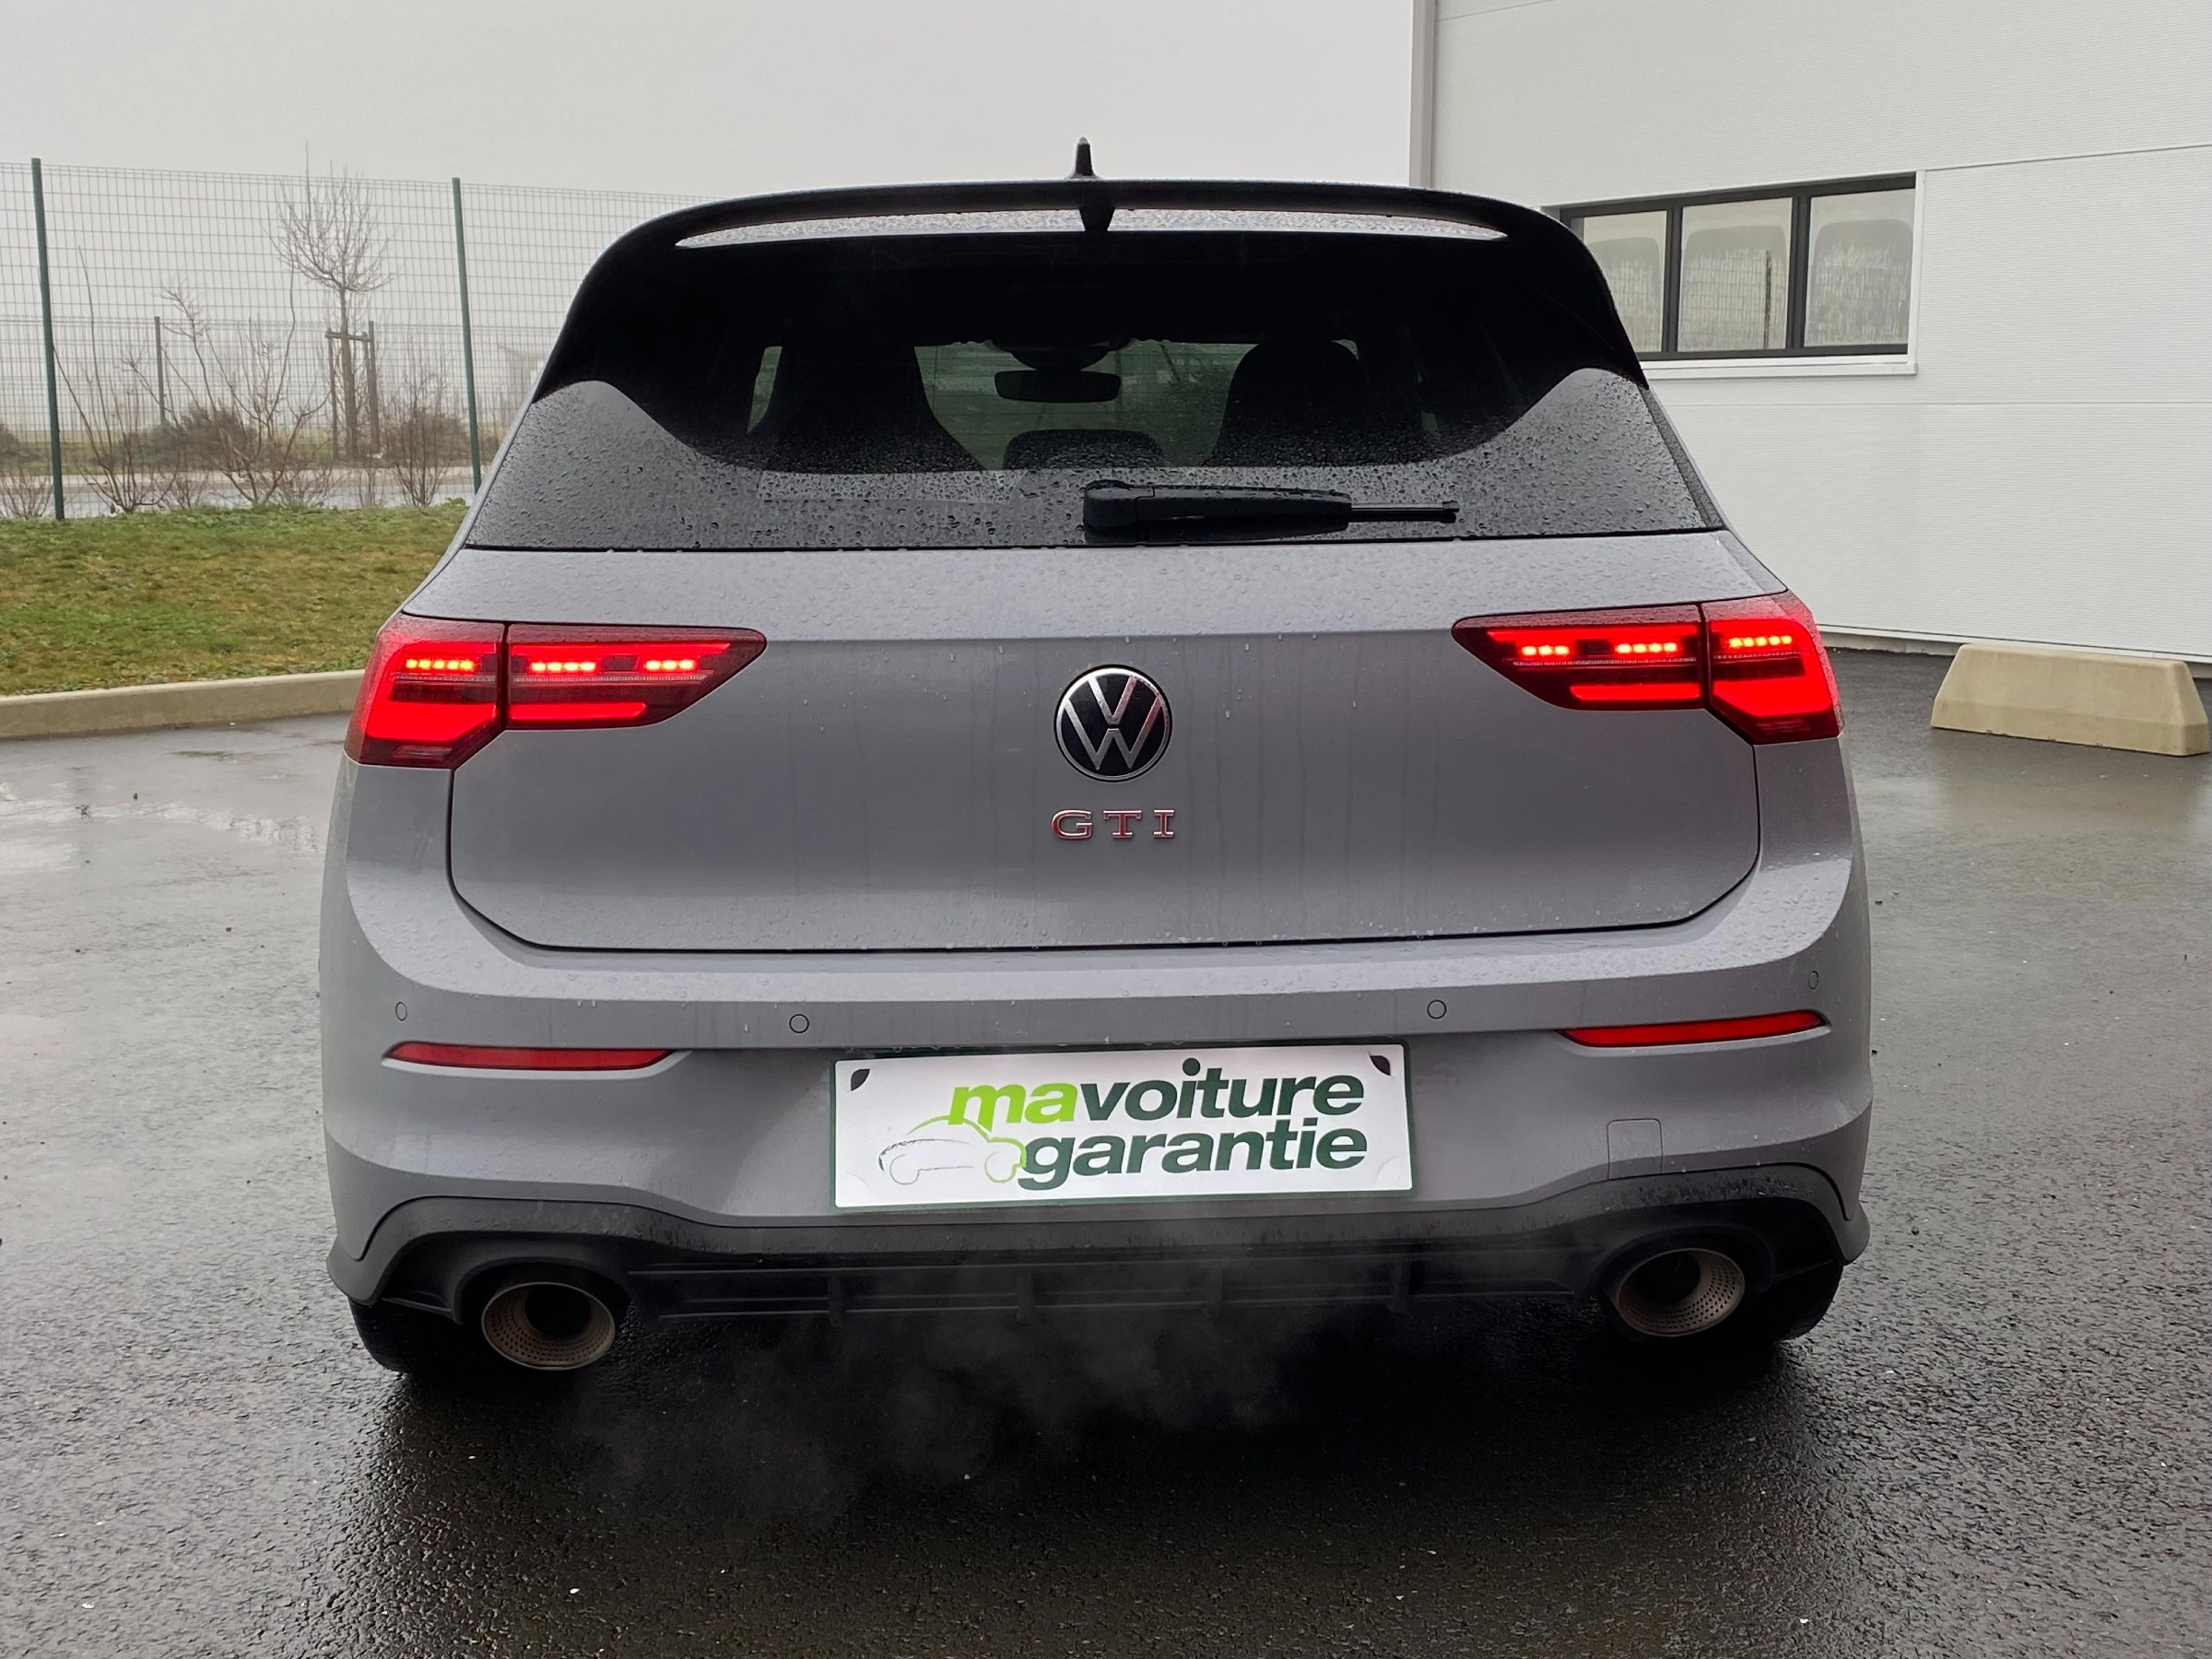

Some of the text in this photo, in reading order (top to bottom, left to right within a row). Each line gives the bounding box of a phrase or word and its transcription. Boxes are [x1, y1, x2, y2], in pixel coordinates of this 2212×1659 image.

[1052, 809, 1174, 840] GTI
[947, 1057, 1364, 1128] mavoiture
[1018, 1119, 1368, 1190] garantie
